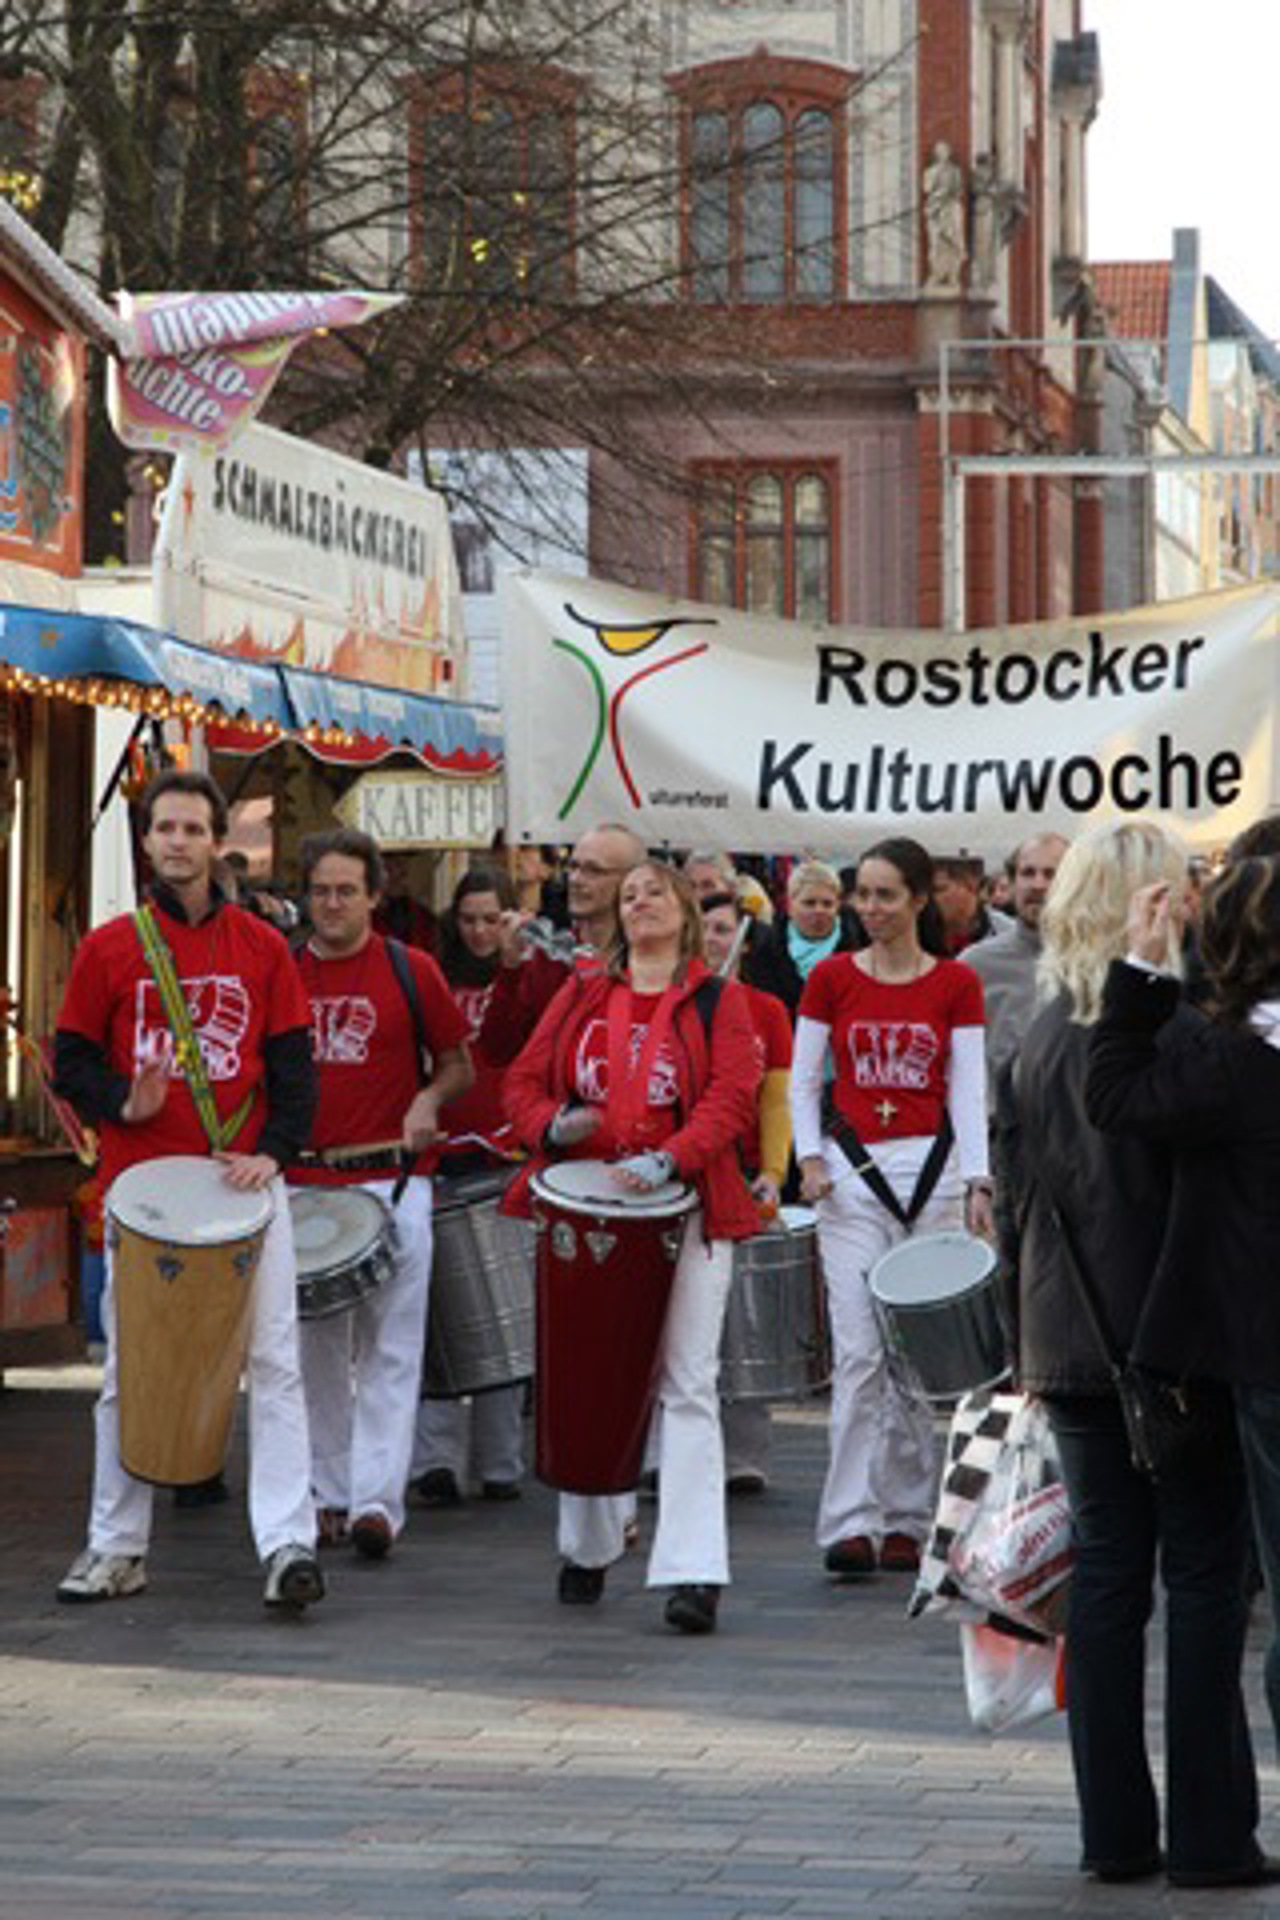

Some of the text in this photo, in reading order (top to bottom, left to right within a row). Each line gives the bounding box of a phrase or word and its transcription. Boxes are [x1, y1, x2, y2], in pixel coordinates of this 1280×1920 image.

[214, 458, 425, 577] SCHMALZBÄCKEREI
[814, 632, 1205, 707] Rostocker
[756, 734, 1244, 813] Kulturwoche
